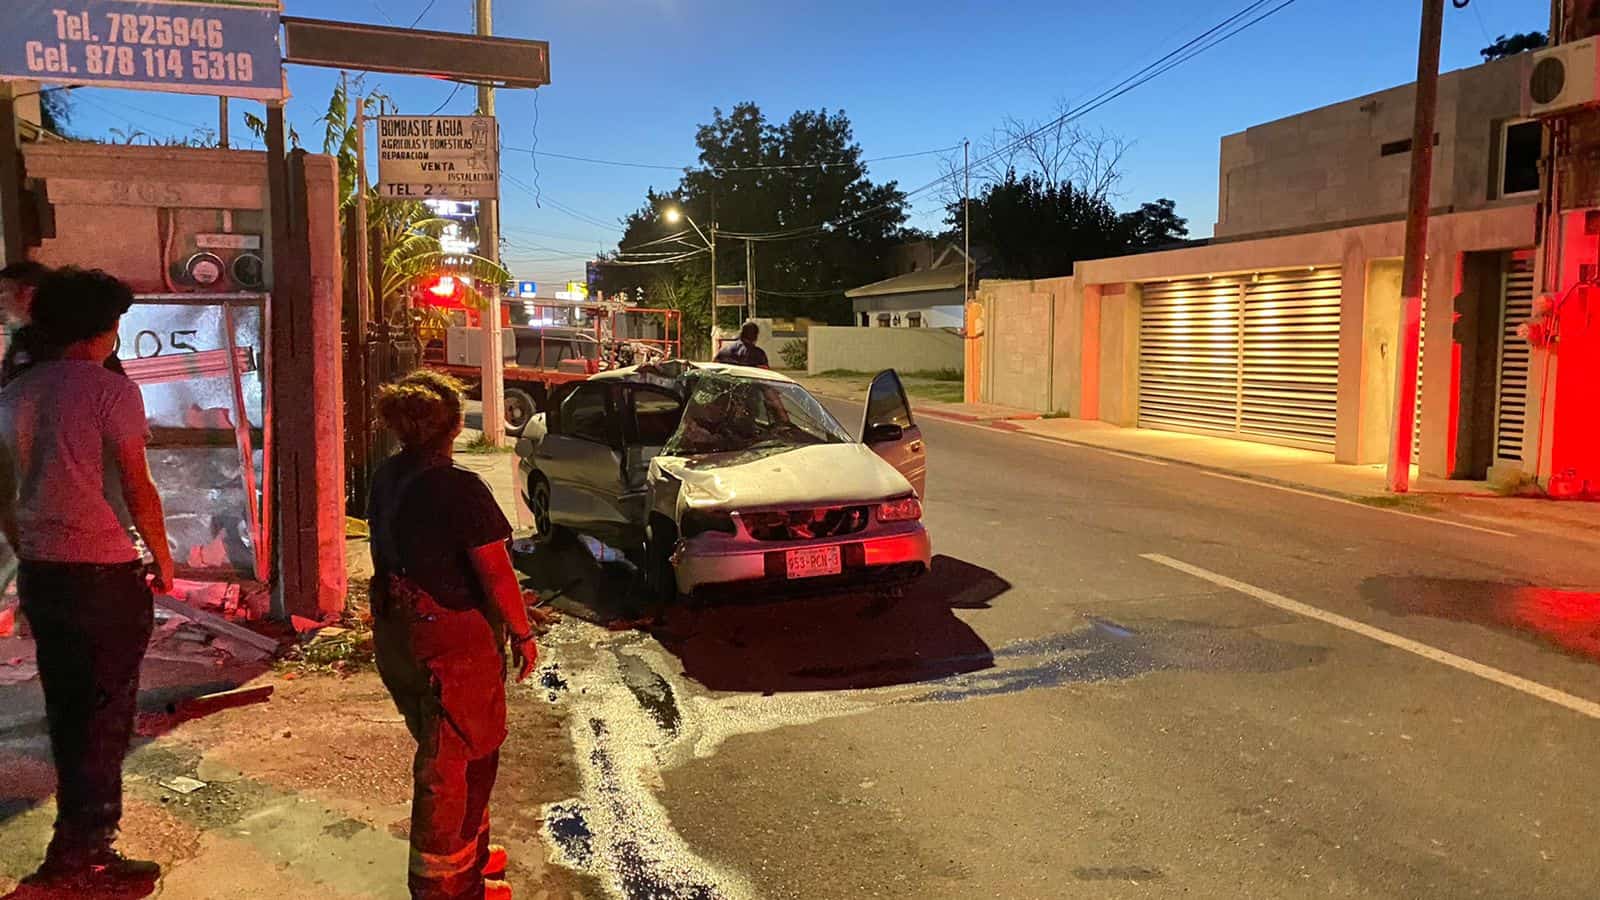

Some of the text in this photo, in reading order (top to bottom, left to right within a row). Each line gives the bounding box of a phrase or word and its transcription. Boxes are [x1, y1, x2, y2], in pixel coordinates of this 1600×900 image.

[53, 9, 223, 49] Tel. 7825946
[25, 40, 253, 81] Cel. 878 114 5319
[381, 119, 463, 137] BOMBAS DE AGUA
[422, 139, 428, 149] Y
[381, 151, 429, 160] REPARACION
[420, 161, 455, 171] VENTA
[387, 183, 416, 196] TEL.
